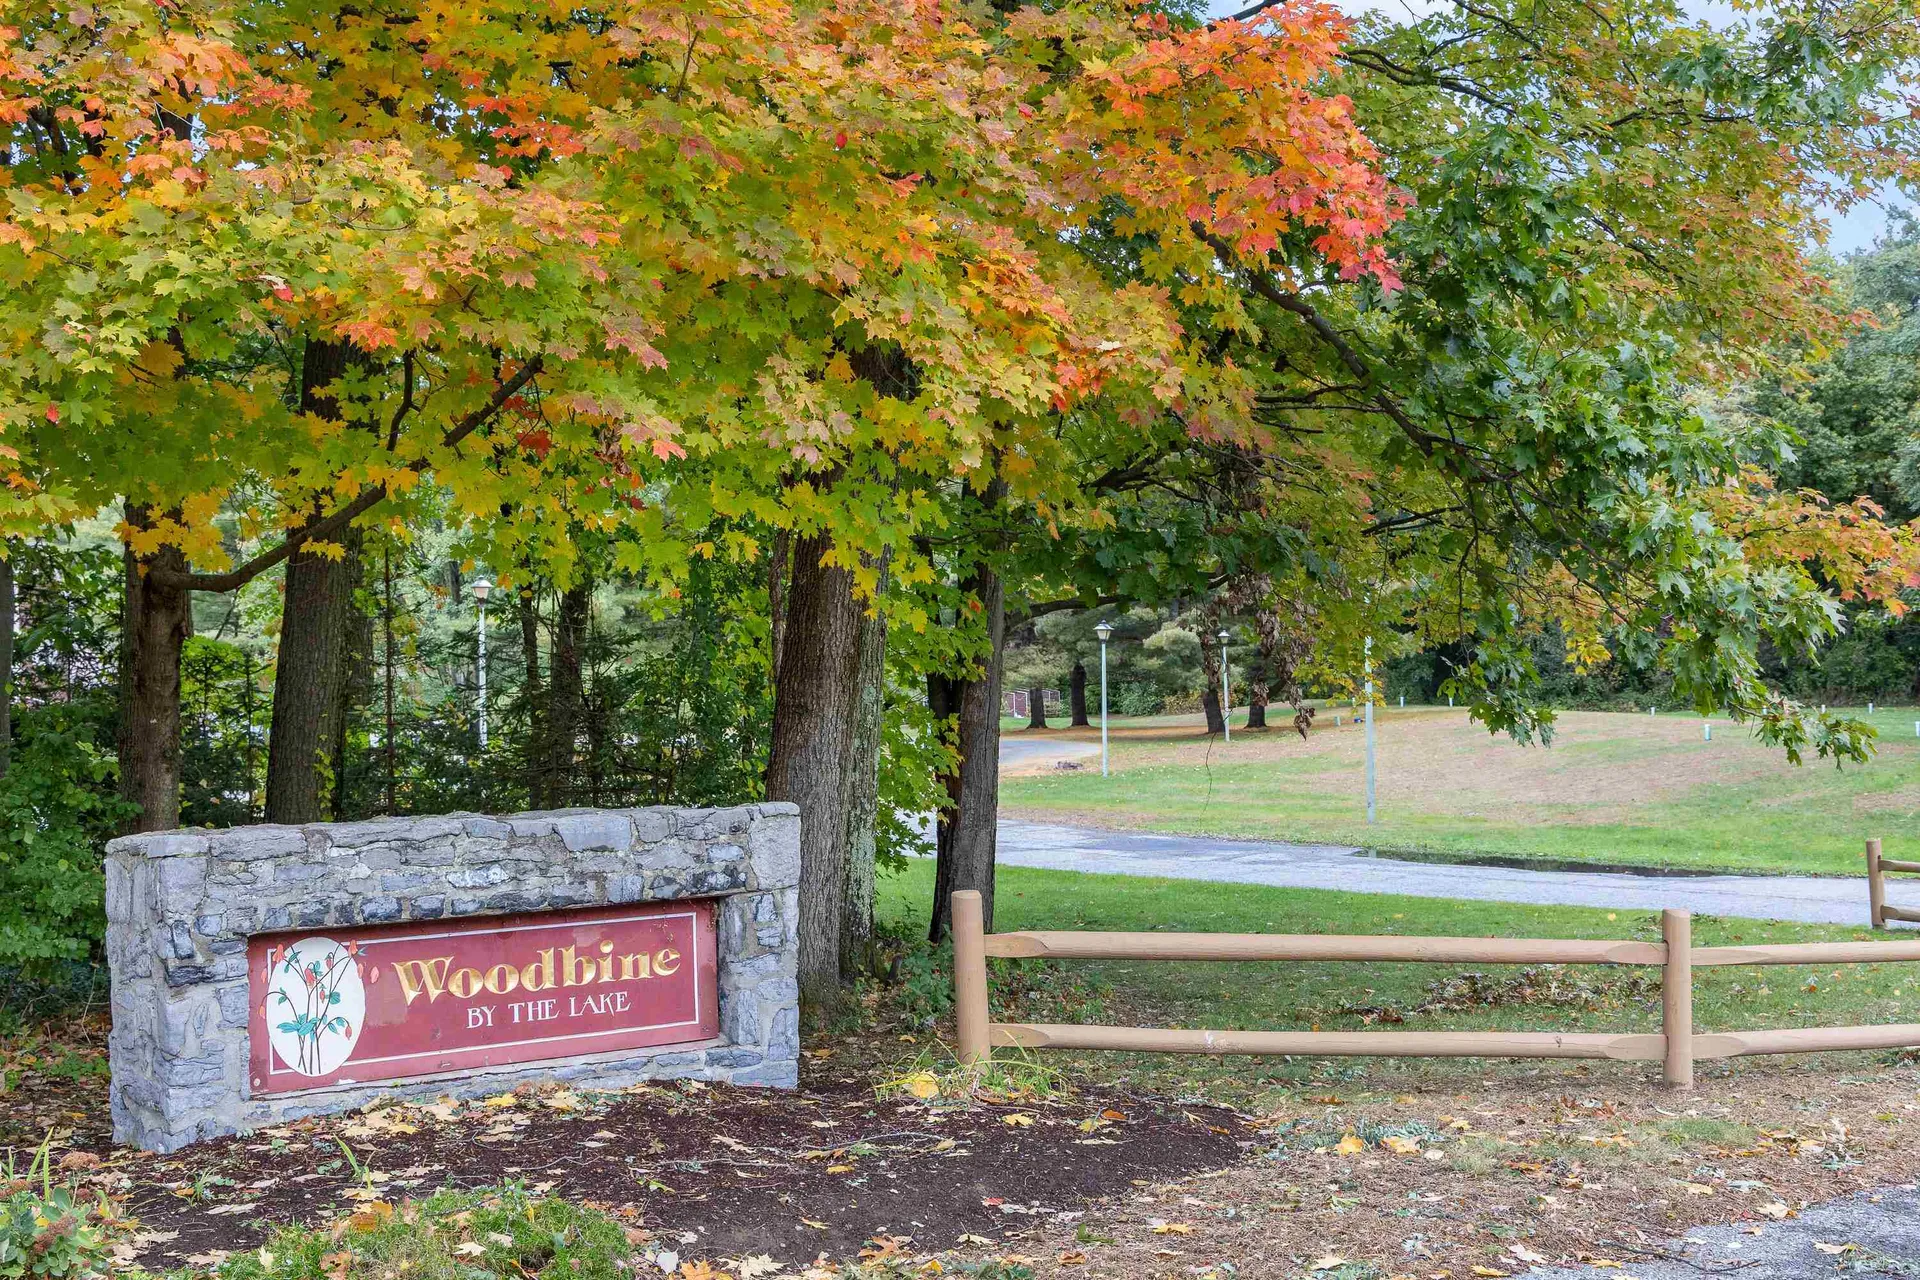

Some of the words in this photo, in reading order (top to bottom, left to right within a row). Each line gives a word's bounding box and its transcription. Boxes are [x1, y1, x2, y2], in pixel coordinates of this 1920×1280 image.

[392, 941, 681, 1006] Woodbine
[467, 1006, 497, 1029] BY
[508, 999, 559, 1023] THE
[569, 991, 631, 1016] LAKE
